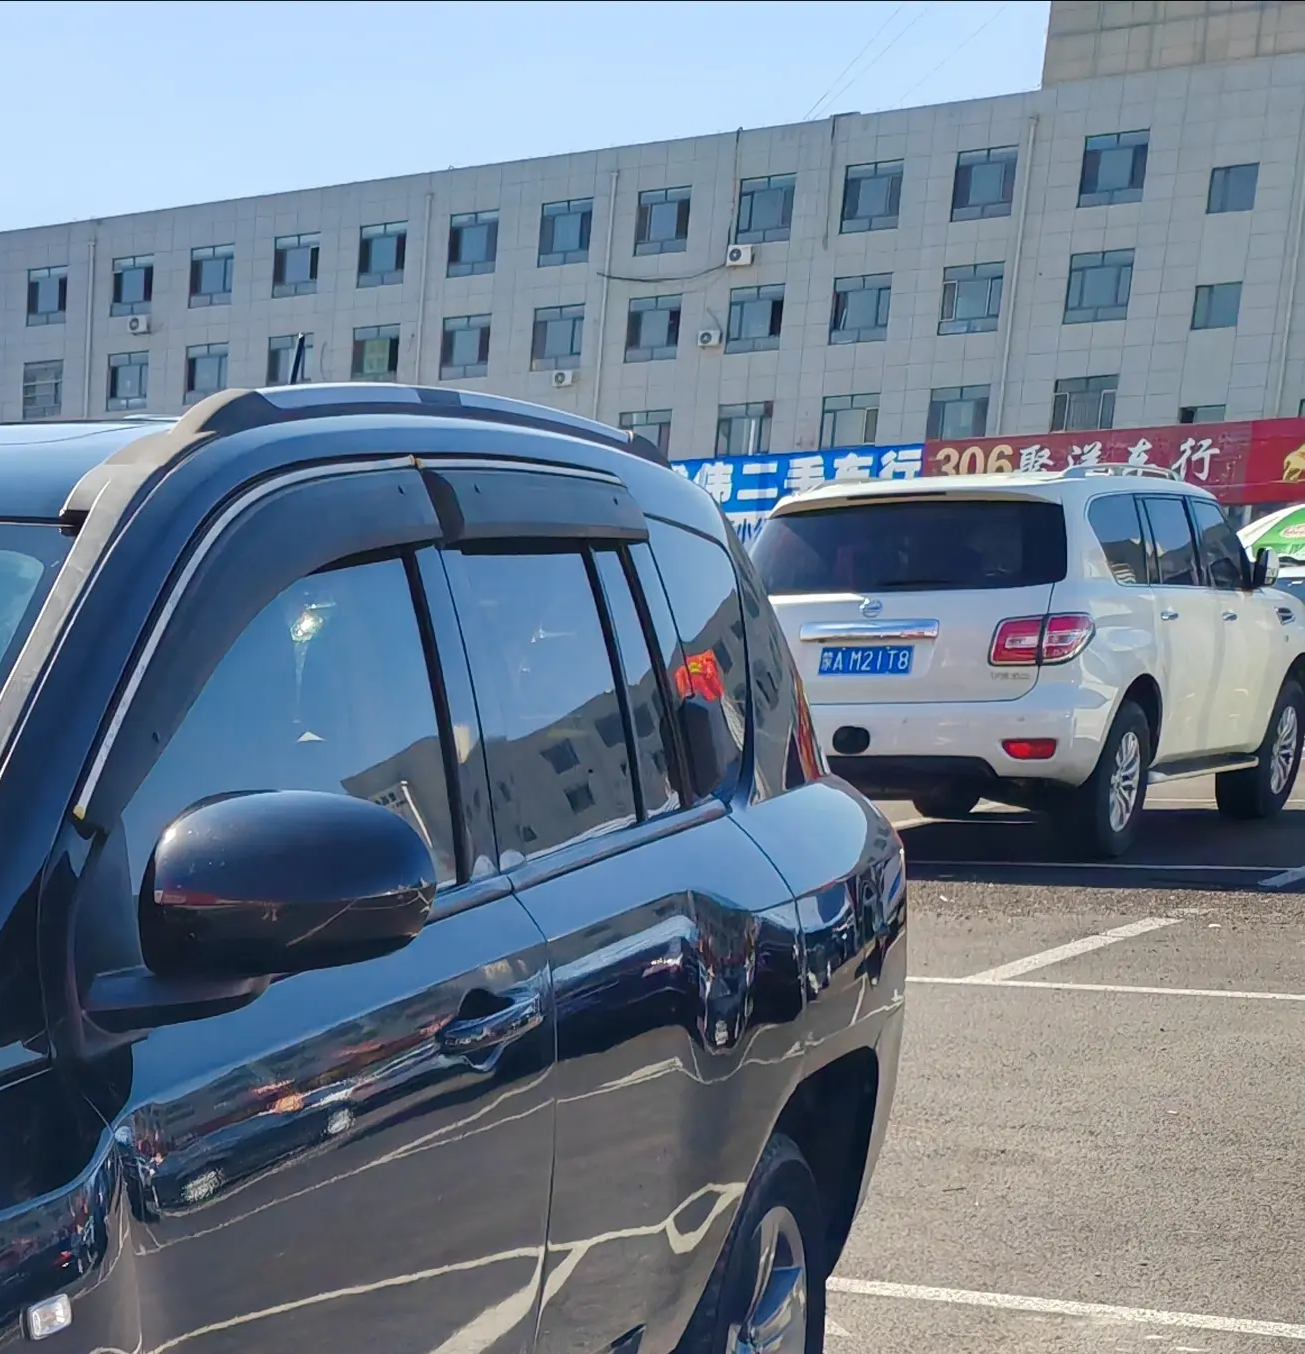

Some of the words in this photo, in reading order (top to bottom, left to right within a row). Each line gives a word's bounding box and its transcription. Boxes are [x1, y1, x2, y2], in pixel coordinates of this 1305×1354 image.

[673, 448, 922, 502] 伟二手车行
[936, 445, 1013, 475] 306
